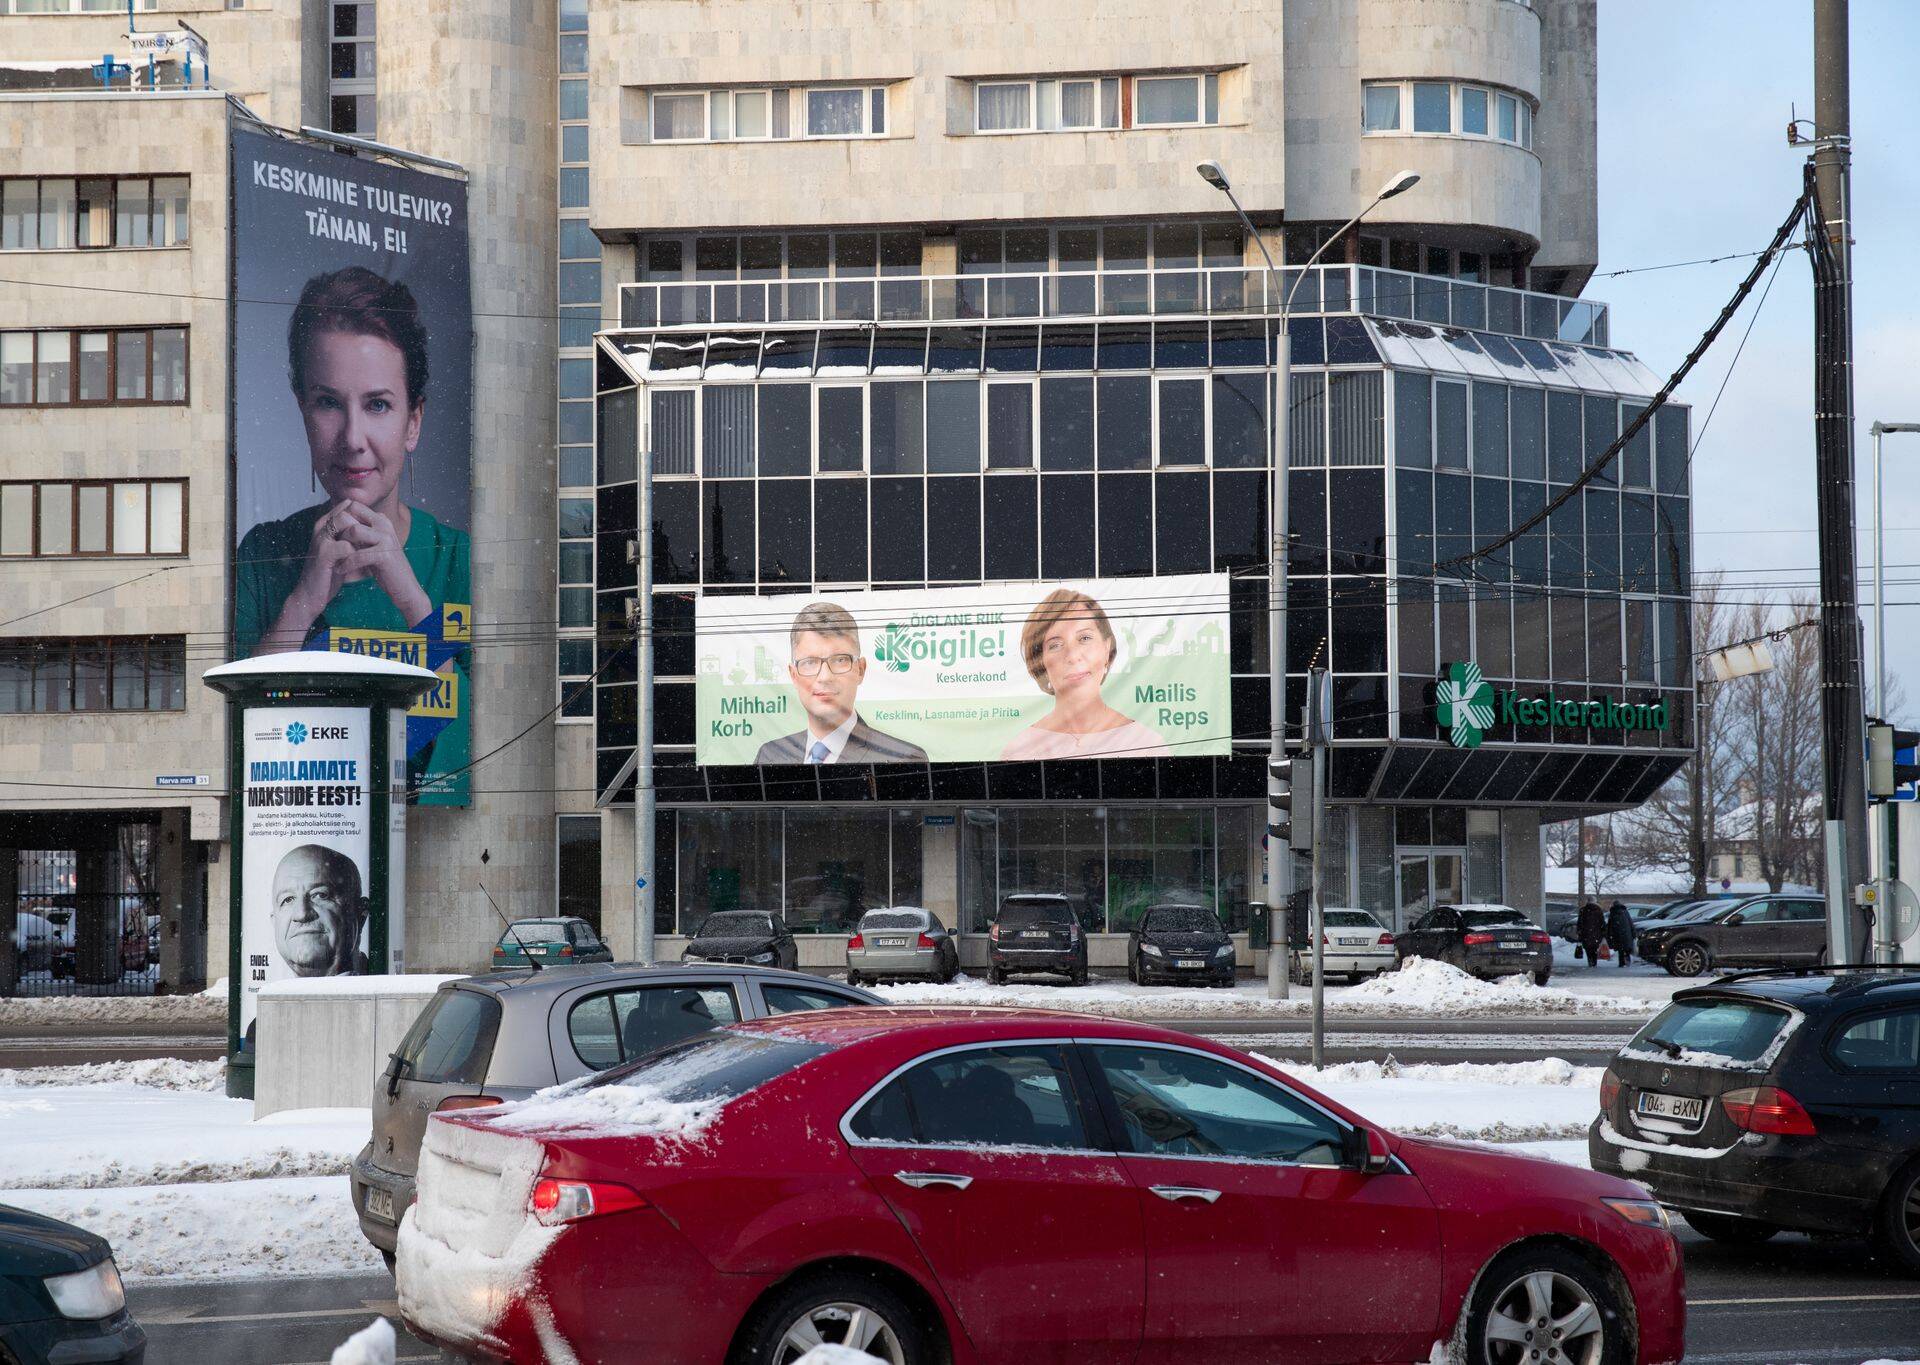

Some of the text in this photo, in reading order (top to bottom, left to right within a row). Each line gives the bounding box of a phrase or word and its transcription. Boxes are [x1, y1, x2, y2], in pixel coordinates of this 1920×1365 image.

[253, 160, 453, 226] KESKMINE TULEVIK?
[305, 207, 408, 254] TÄNAN, EI!
[910, 611, 1004, 627] ÕIGLANE RIIK
[886, 630, 1005, 667] Kõigile!
[936, 671, 1007, 684] Keskerakond
[1135, 683, 1196, 705] Mailis
[720, 696, 787, 716] Mihhail
[875, 706, 1020, 722] Kesklinn, Lasnamäe ja Pirita
[1502, 689, 1669, 731] Keskerakond
[711, 718, 753, 738] Korb
[1158, 708, 1209, 730] Reps
[311, 727, 348, 740] EKRE
[159, 777, 179, 785] Narva
[250, 760, 356, 782] MADALAMATE
[248, 785, 361, 807] MAKSUDE EEST!
[342, 819, 356, 829] ning
[250, 954, 270, 967] ENDEL
[252, 969, 266, 981] OJA
[1673, 1100, 1700, 1118] BXN
